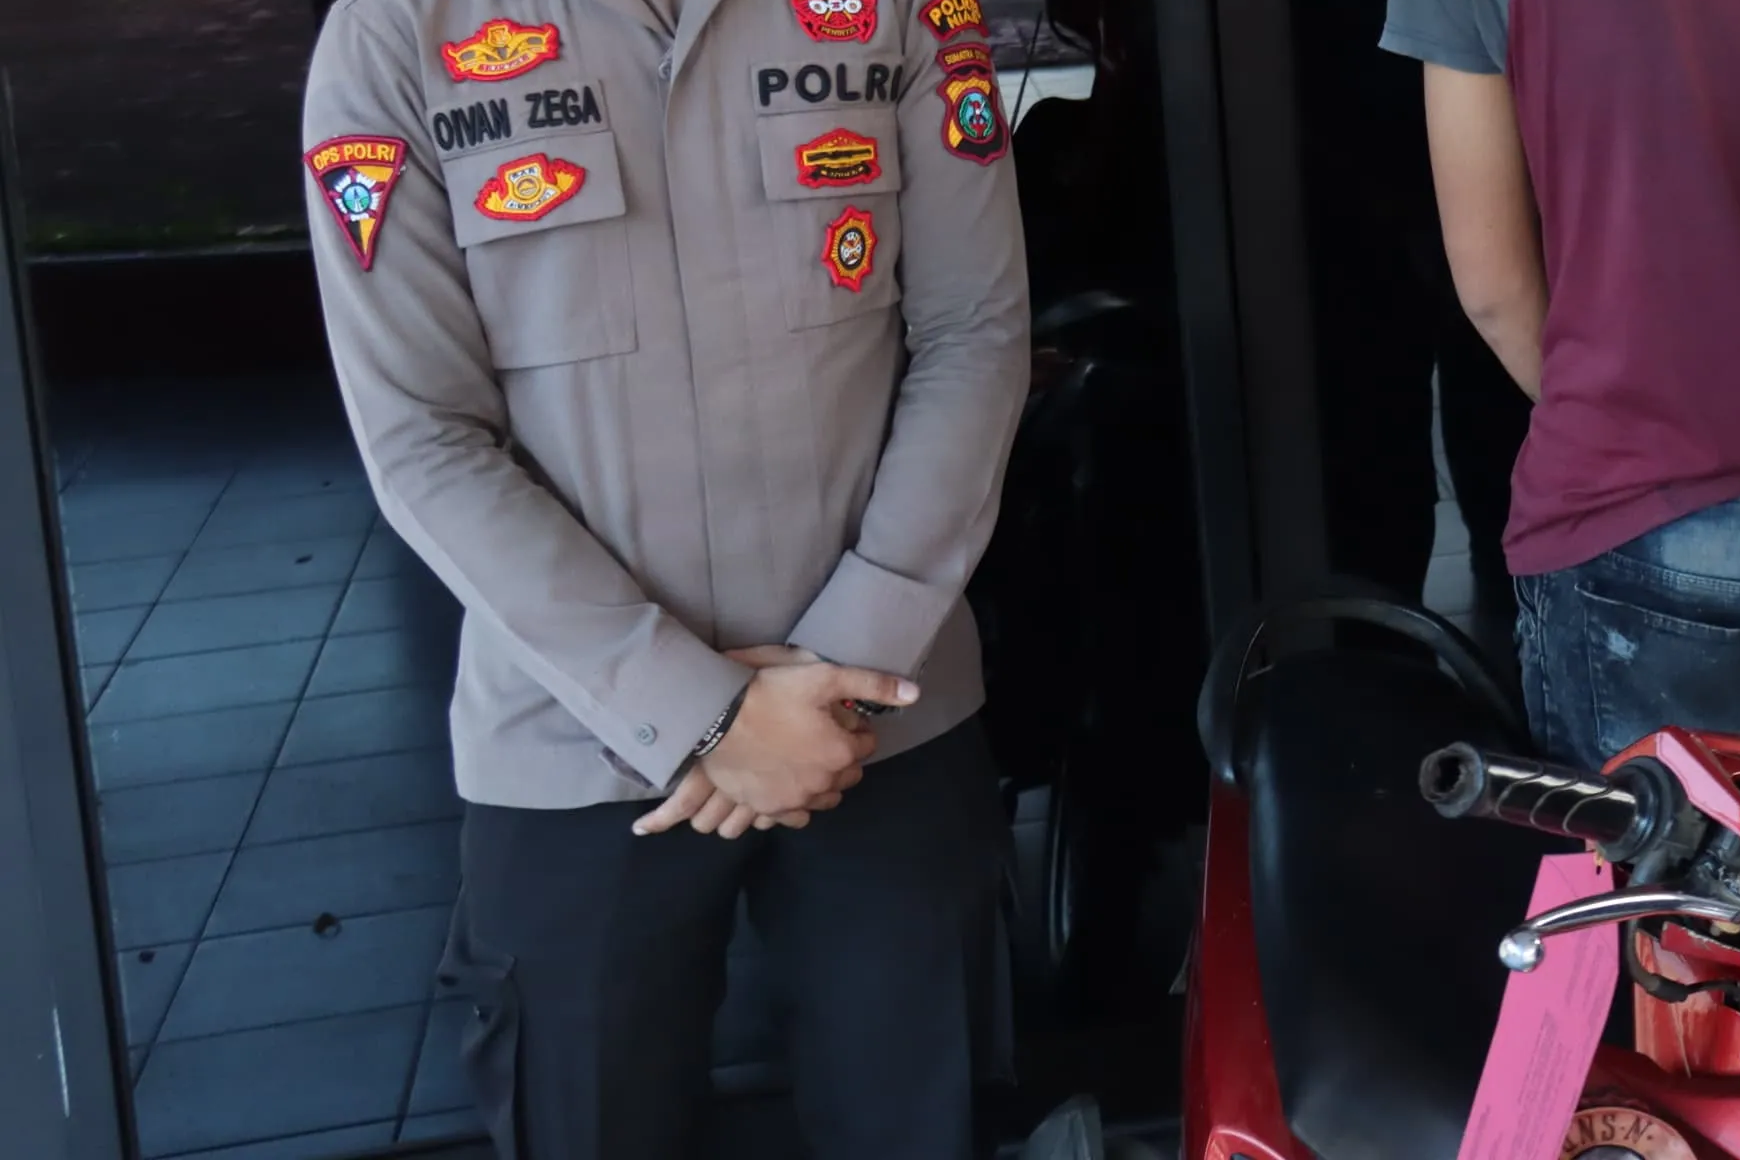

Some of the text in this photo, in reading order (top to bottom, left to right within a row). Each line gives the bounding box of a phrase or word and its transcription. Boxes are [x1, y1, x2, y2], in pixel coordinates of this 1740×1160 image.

[525, 85, 602, 129] ZEGA
[758, 63, 903, 107] POLRI
[313, 143, 396, 170] OPS POLRI
